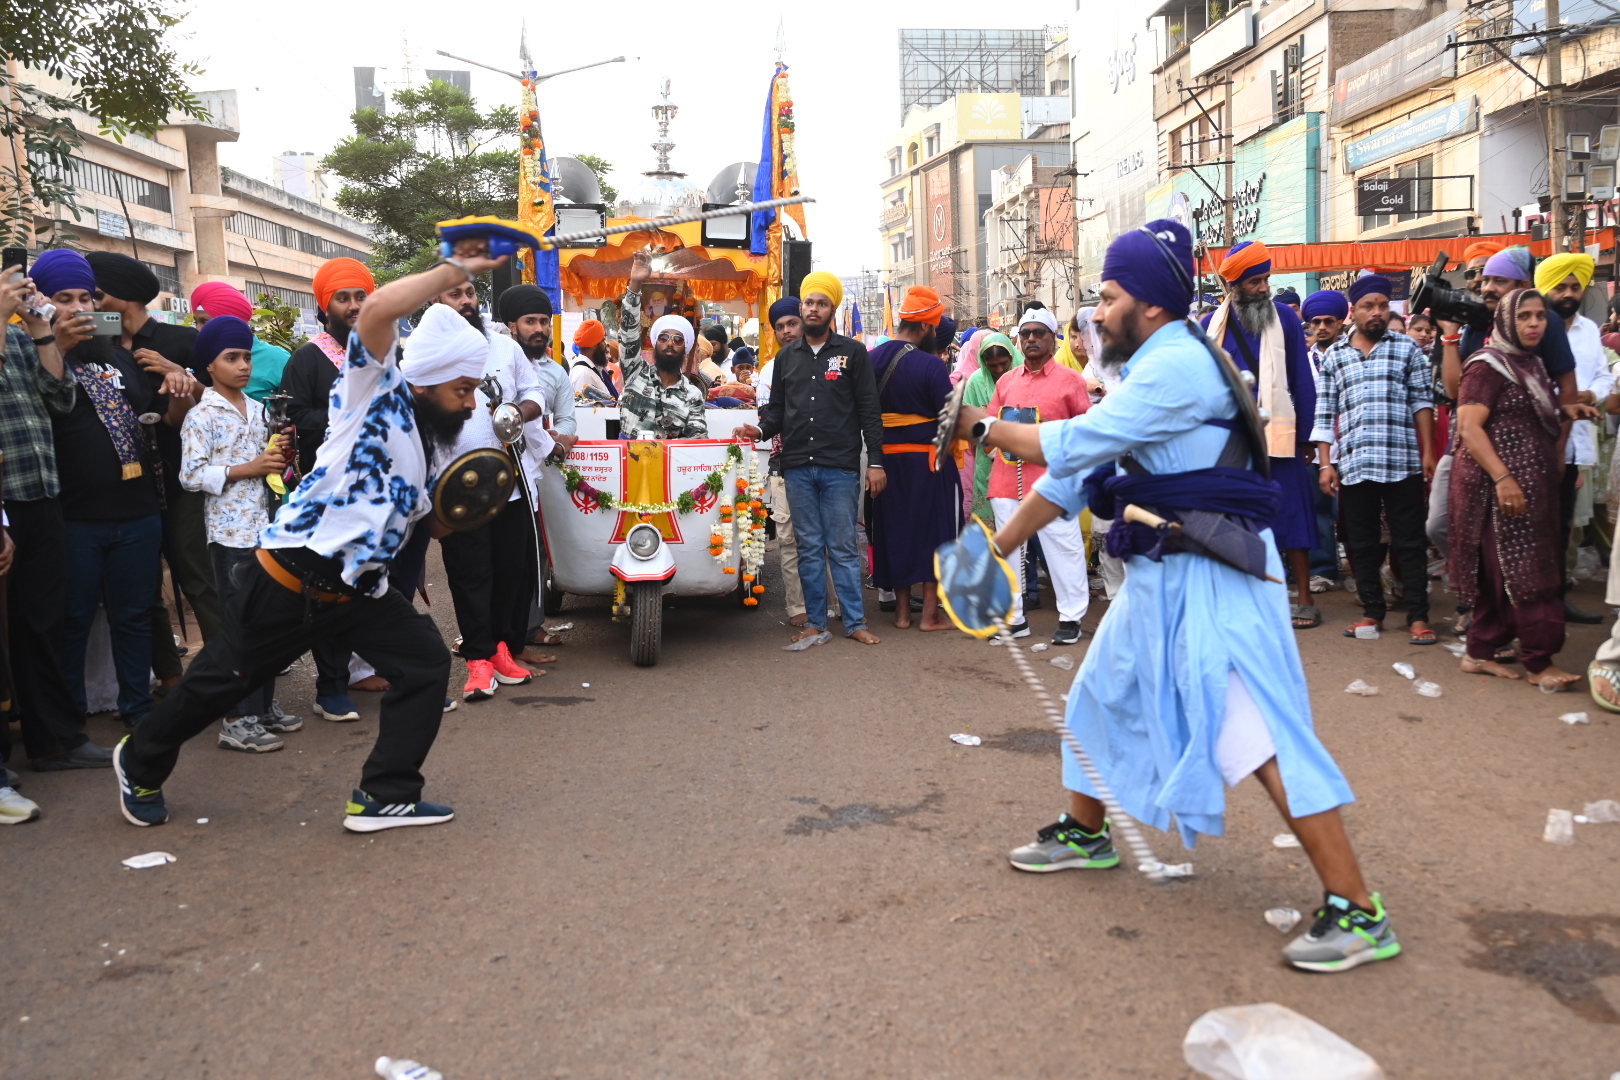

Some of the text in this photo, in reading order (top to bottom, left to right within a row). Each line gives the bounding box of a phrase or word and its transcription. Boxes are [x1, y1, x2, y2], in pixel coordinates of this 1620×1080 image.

[1356, 131, 1397, 156] Swarna
[1396, 114, 1447, 140] CONSTRUCTIONS
[1116, 150, 1143, 178] TRENDS
[1363, 181, 1389, 193] Balaji
[1381, 194, 1404, 205] Gold
